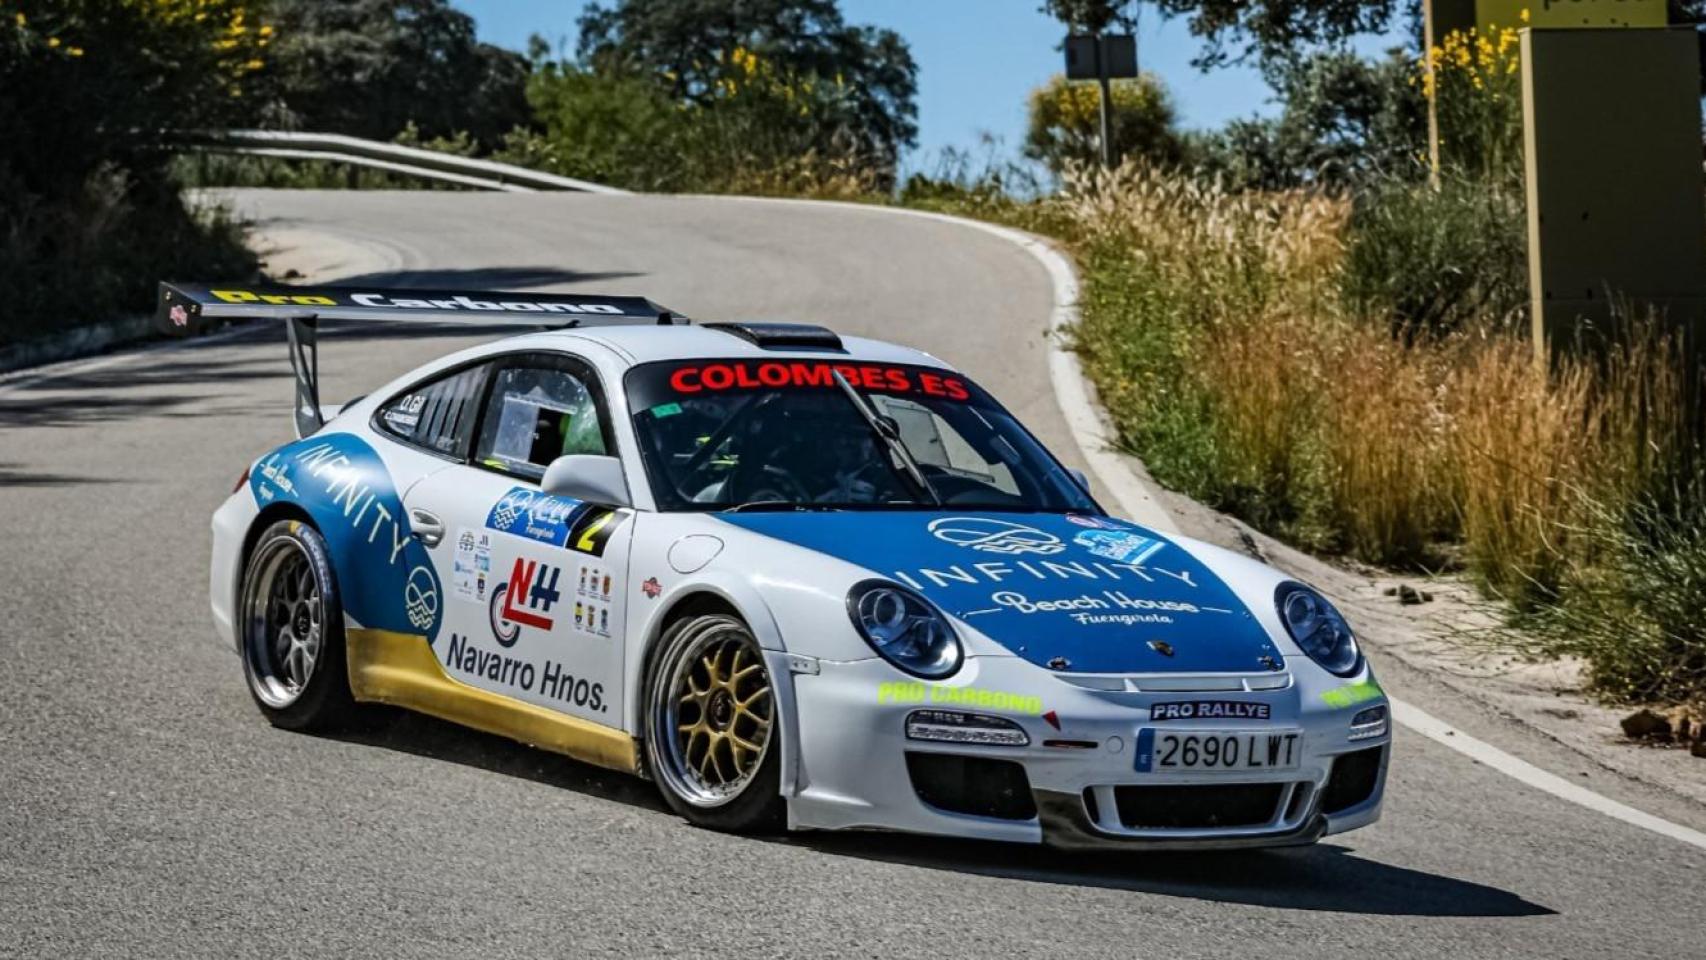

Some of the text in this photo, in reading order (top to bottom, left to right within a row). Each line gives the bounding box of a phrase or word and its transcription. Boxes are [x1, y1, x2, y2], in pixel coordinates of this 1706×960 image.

[210, 290, 625, 314] Pro Carbono
[576, 510, 616, 552] 2
[895, 560, 1198, 590] INFINITY
[992, 591, 1200, 614] Beach House
[1069, 613, 1175, 625] Fuengirola
[446, 632, 608, 713] Navarro Hnos.
[878, 682, 1042, 716] PRO CARBONO
[1153, 703, 1269, 719] PRO RALLYE
[1160, 735, 1239, 767] 2690
[1247, 734, 1299, 767] LWT
